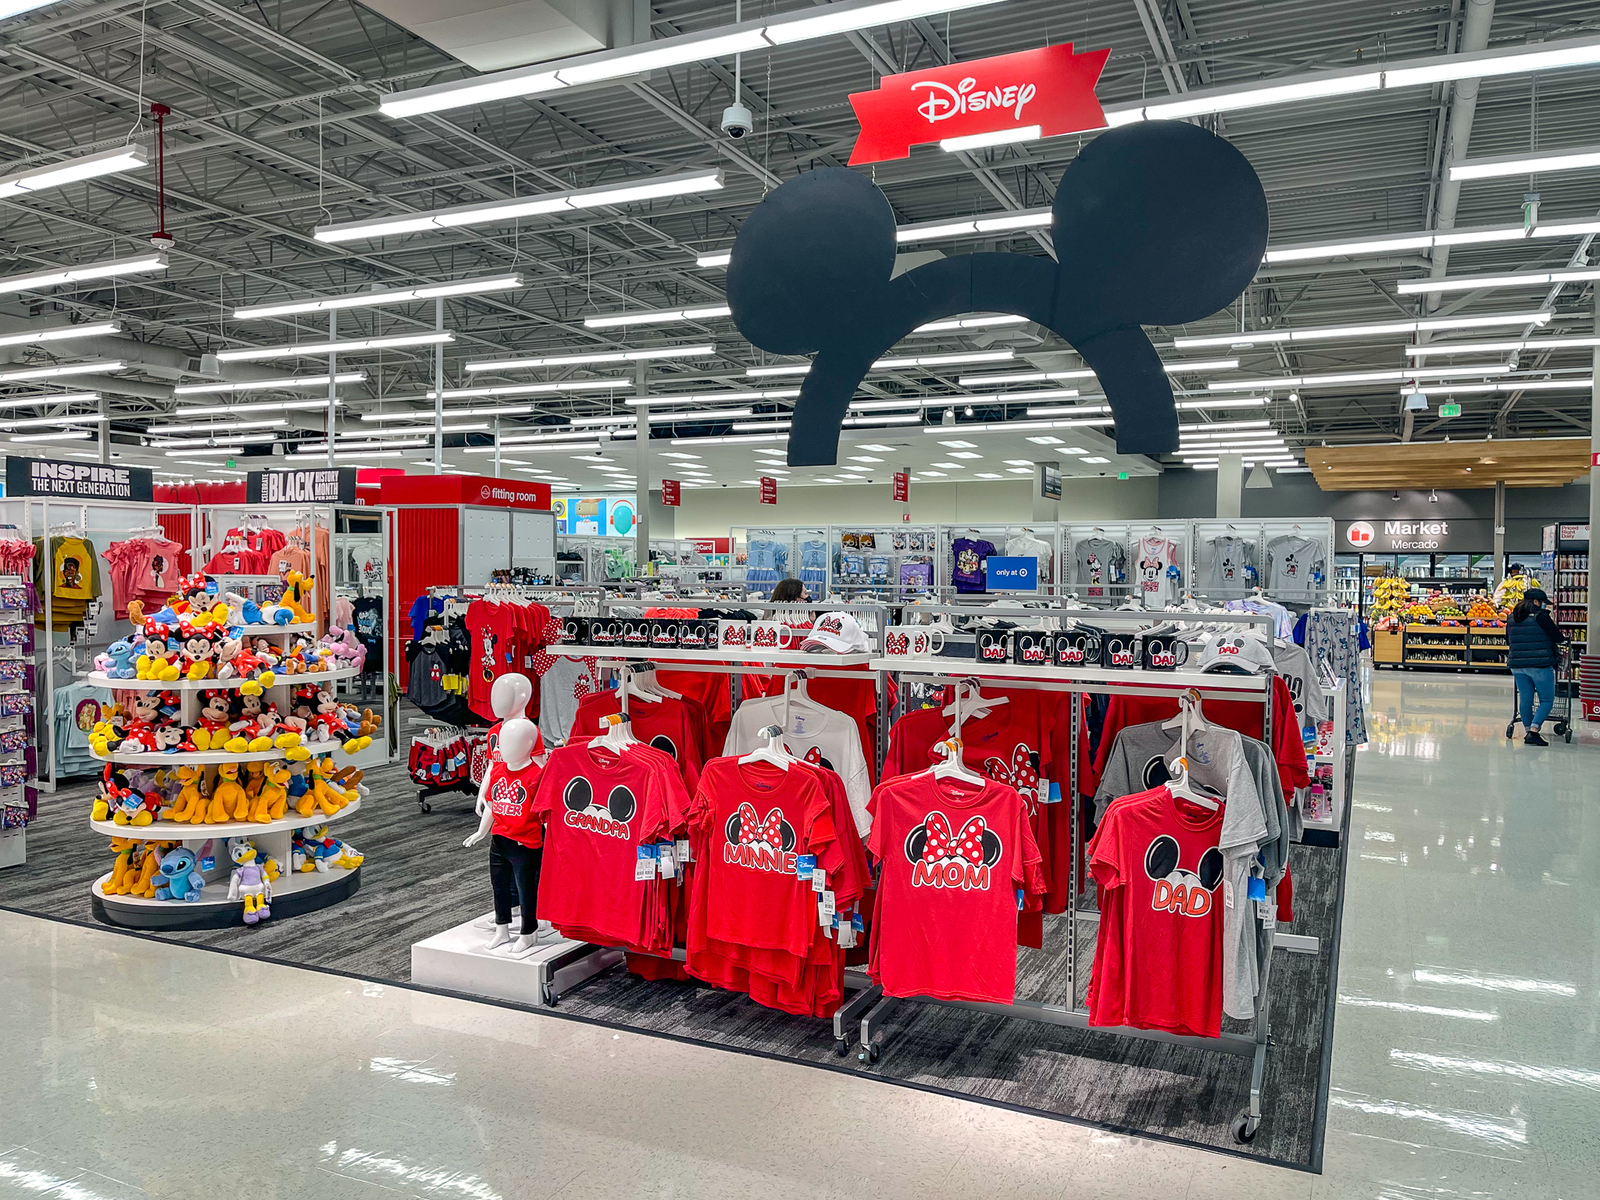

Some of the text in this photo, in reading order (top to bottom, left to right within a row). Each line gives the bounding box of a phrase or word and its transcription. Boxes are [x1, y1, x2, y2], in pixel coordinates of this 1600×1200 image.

[31, 462, 130, 484] INSPIRE
[315, 470, 339, 482] HISTORY
[32, 478, 131, 497] THE NEXT GENERATION
[261, 473, 269, 502] CELEBRATE
[269, 471, 316, 502] BLACK
[315, 482, 338, 496] MONTH
[491, 487, 537, 503] fitting room
[1383, 521, 1448, 536] Market
[1391, 539, 1438, 549] Mercado
[996, 568, 1010, 577] only
[887, 645, 908, 656] MOM
[983, 647, 1006, 659] DAD
[1024, 649, 1046, 661] DAD
[1060, 650, 1084, 662] DAD
[1218, 646, 1240, 655] DAD
[1112, 653, 1134, 665] DAD
[1153, 655, 1176, 666] DAD
[564, 809, 630, 839] GRANDPA
[724, 842, 798, 874] MINNIE
[912, 859, 991, 890] MOM
[1152, 878, 1212, 917] DAD
